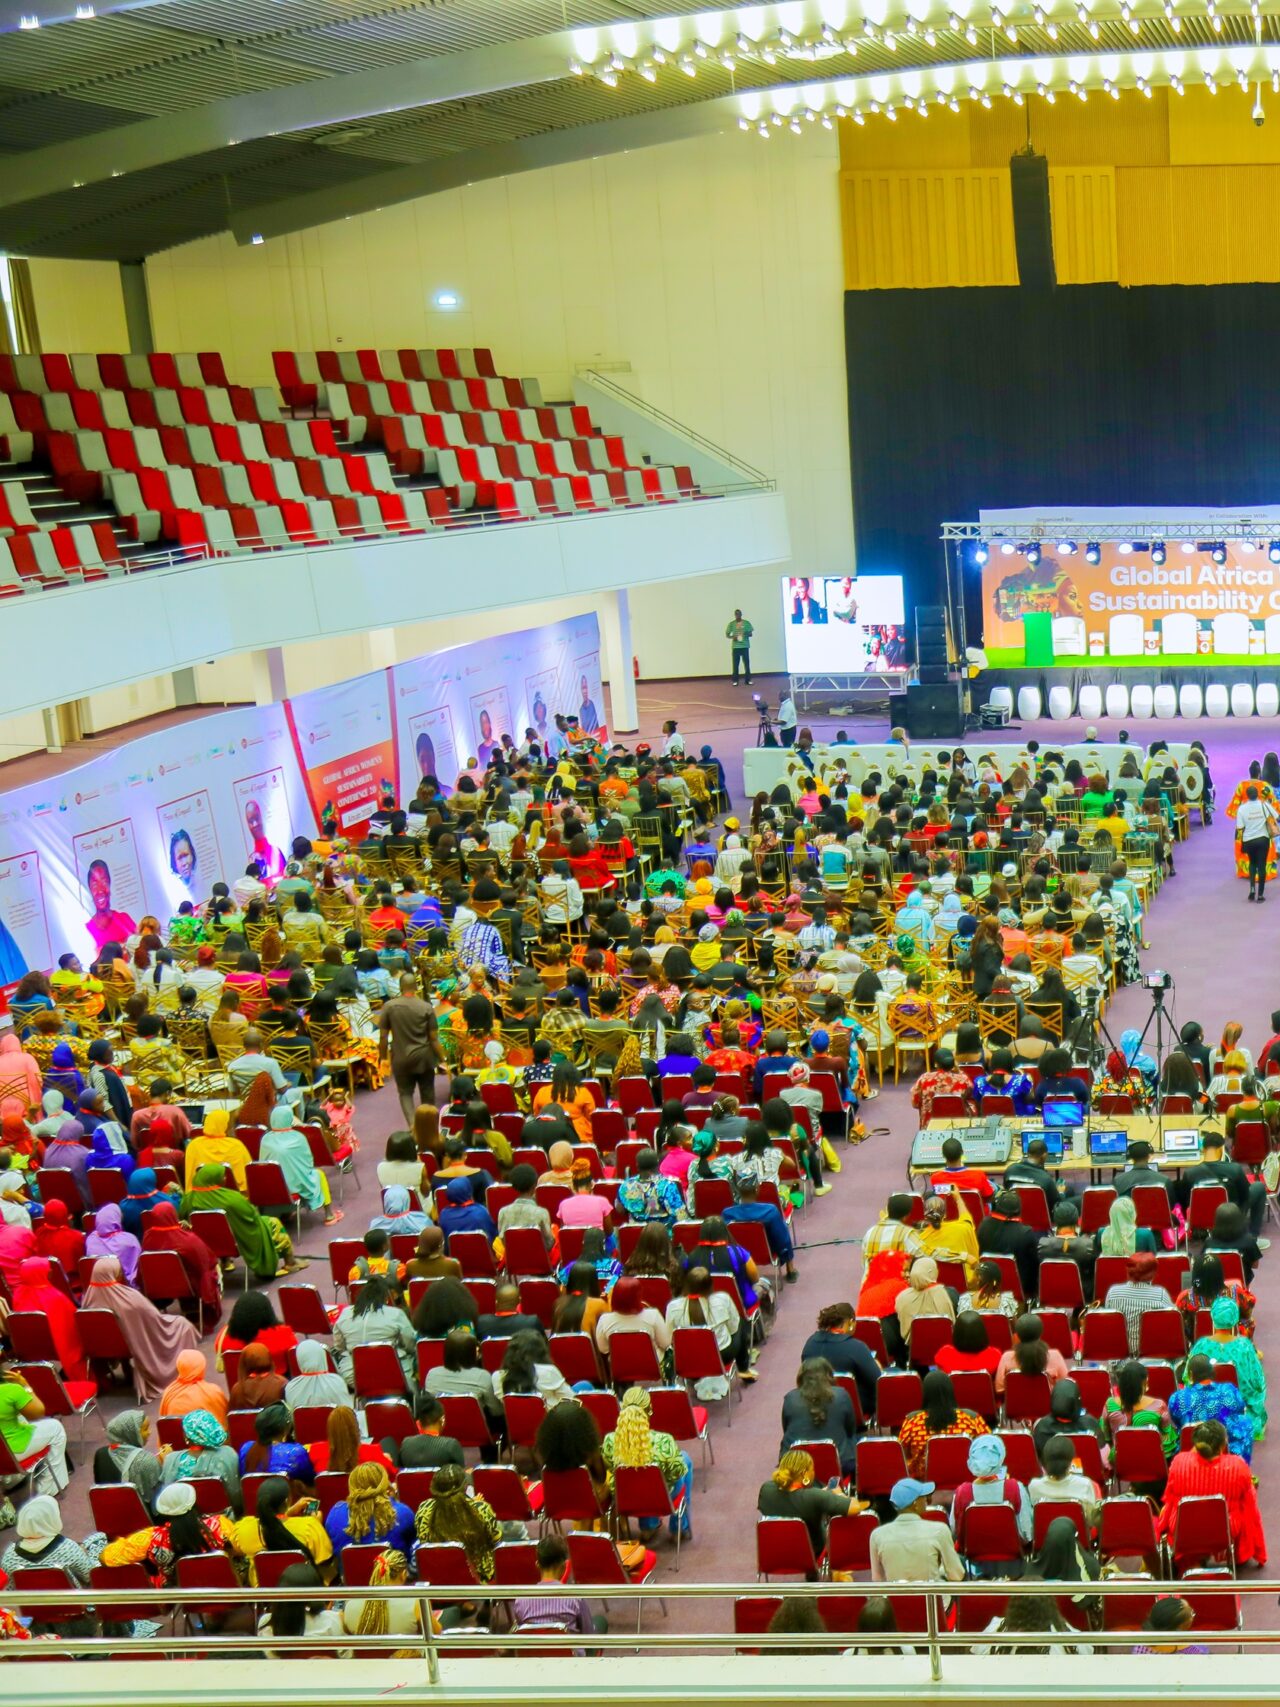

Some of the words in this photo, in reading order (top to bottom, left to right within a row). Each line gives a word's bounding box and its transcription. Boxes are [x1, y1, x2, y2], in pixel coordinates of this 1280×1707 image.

[1110, 566, 1192, 586] Global
[1197, 565, 1274, 586] Africa
[1088, 590, 1264, 614] Sustainability
